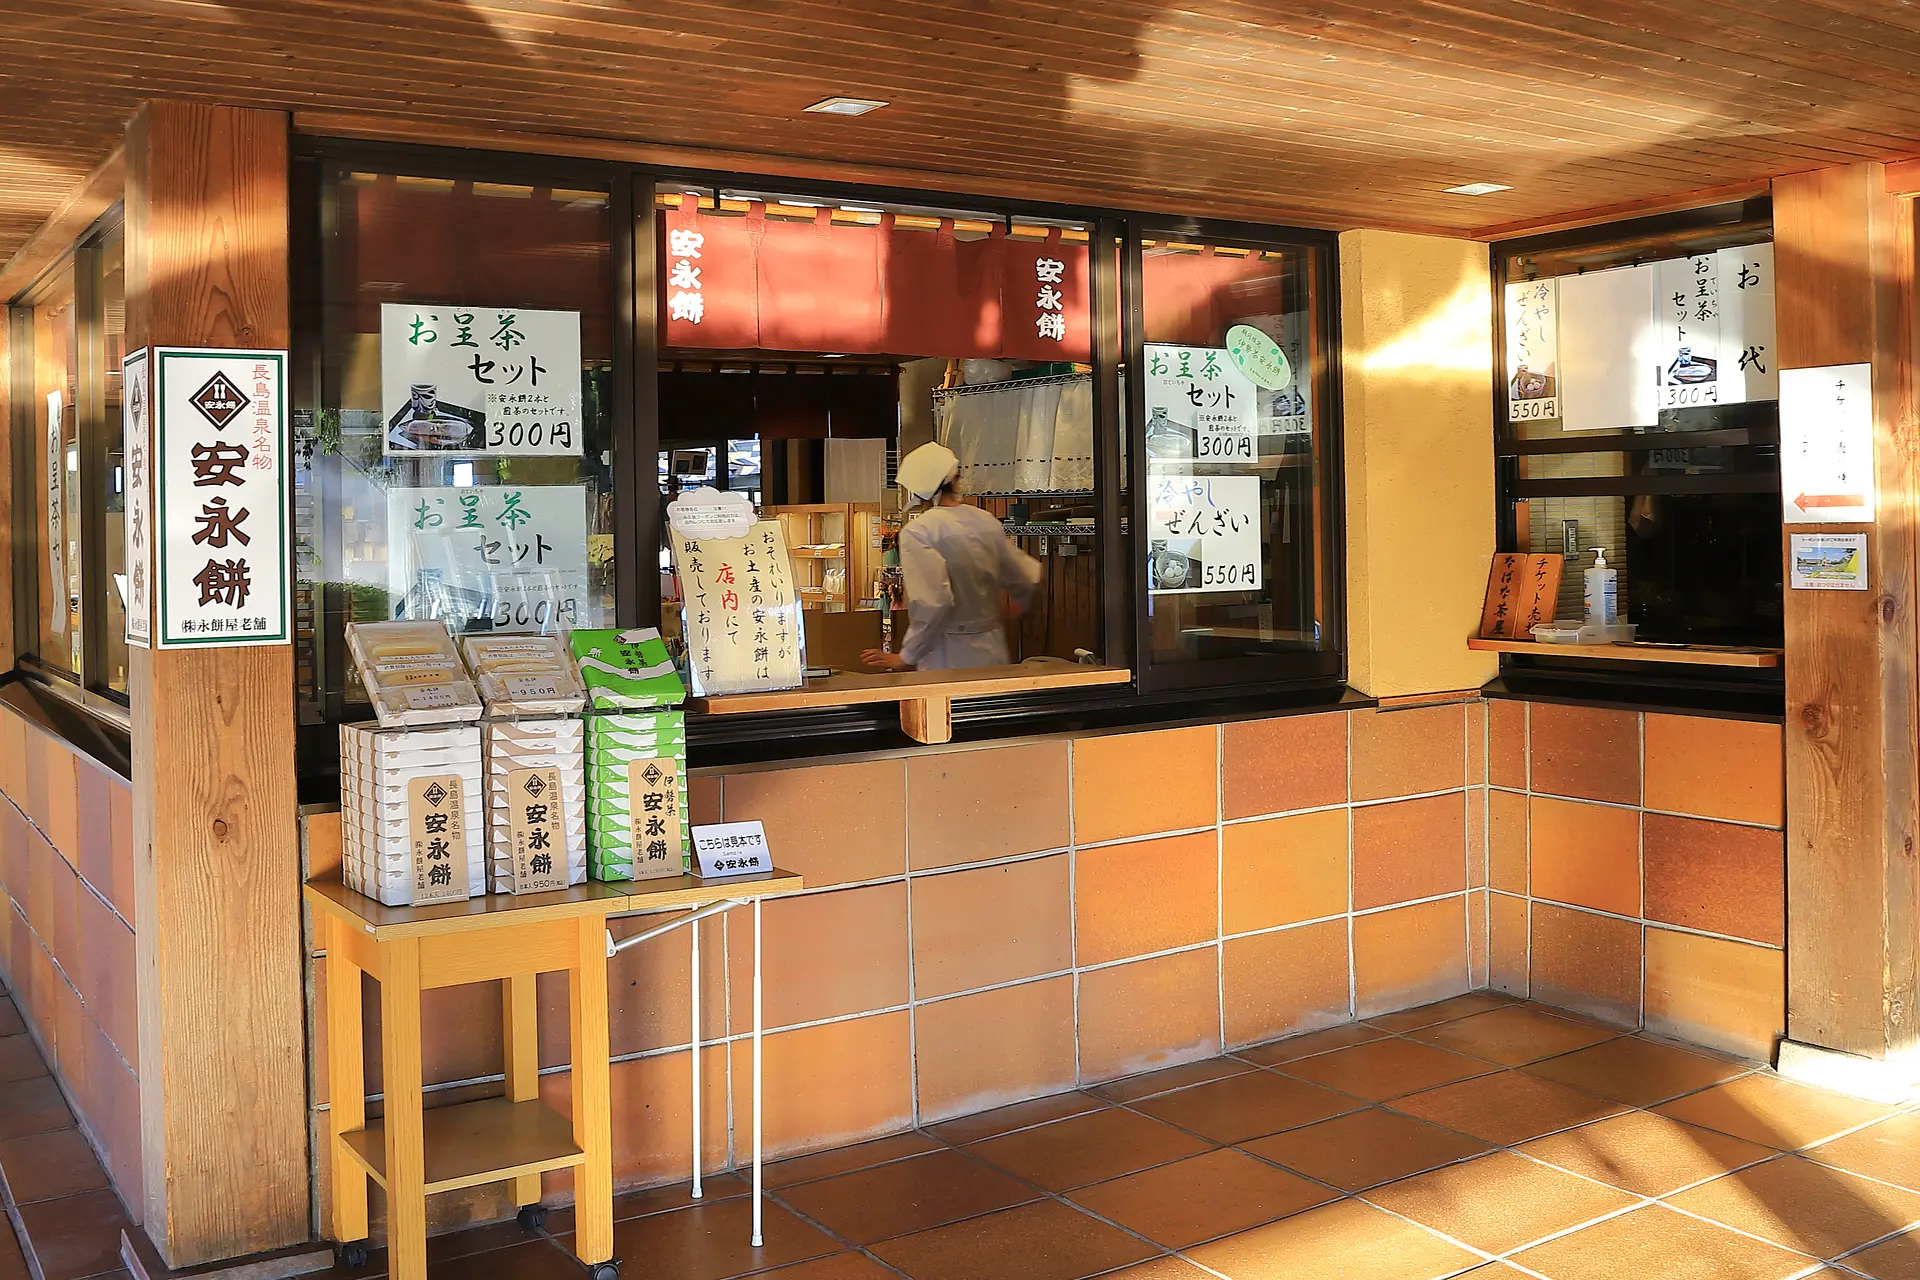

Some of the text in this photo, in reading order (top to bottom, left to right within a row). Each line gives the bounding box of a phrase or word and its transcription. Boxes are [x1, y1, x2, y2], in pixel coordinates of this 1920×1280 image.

[669, 228, 705, 325] 安永餅
[1694, 257, 1713, 322] お呈茶
[1035, 257, 1067, 342] 安永餅
[1533, 283, 1550, 343] 冷やし
[1672, 291, 1688, 342] セット
[408, 312, 526, 352] お呈茶
[1515, 290, 1532, 362] ぜんざい
[467, 353, 547, 387] セット
[1149, 350, 1223, 382] お呈茶
[251, 363, 273, 471] 長島温泉名物
[1186, 383, 1237, 409] セット
[1510, 400, 1556, 419] 550円
[1667, 385, 1718, 405] 300円
[488, 421, 572, 449] 300円
[1199, 436, 1252, 458] 300円
[414, 491, 532, 531] お呈茶
[1155, 478, 1216, 508] 冷やし
[190, 440, 251, 610] 安永餅
[1163, 508, 1249, 537] ぜんざい
[473, 533, 553, 565] セット
[762, 531, 792, 660] おそれいりますが
[1203, 563, 1256, 584] 550円
[494, 598, 578, 628] 300円
[684, 541, 715, 682] 販売しております
[715, 562, 739, 646] 店内にて
[742, 543, 770, 680] お土産の安永餅は
[519, 687, 556, 697] 950円
[448, 779, 461, 841] 長島温泉名物
[548, 771, 561, 831] 長島温泉名物
[525, 803, 552, 875] 安永餅
[643, 792, 667, 861] 安永餅
[698, 834, 762, 851] こちらは見本です
[424, 812, 452, 887] 安永餅
[725, 856, 760, 870] 安永餅
